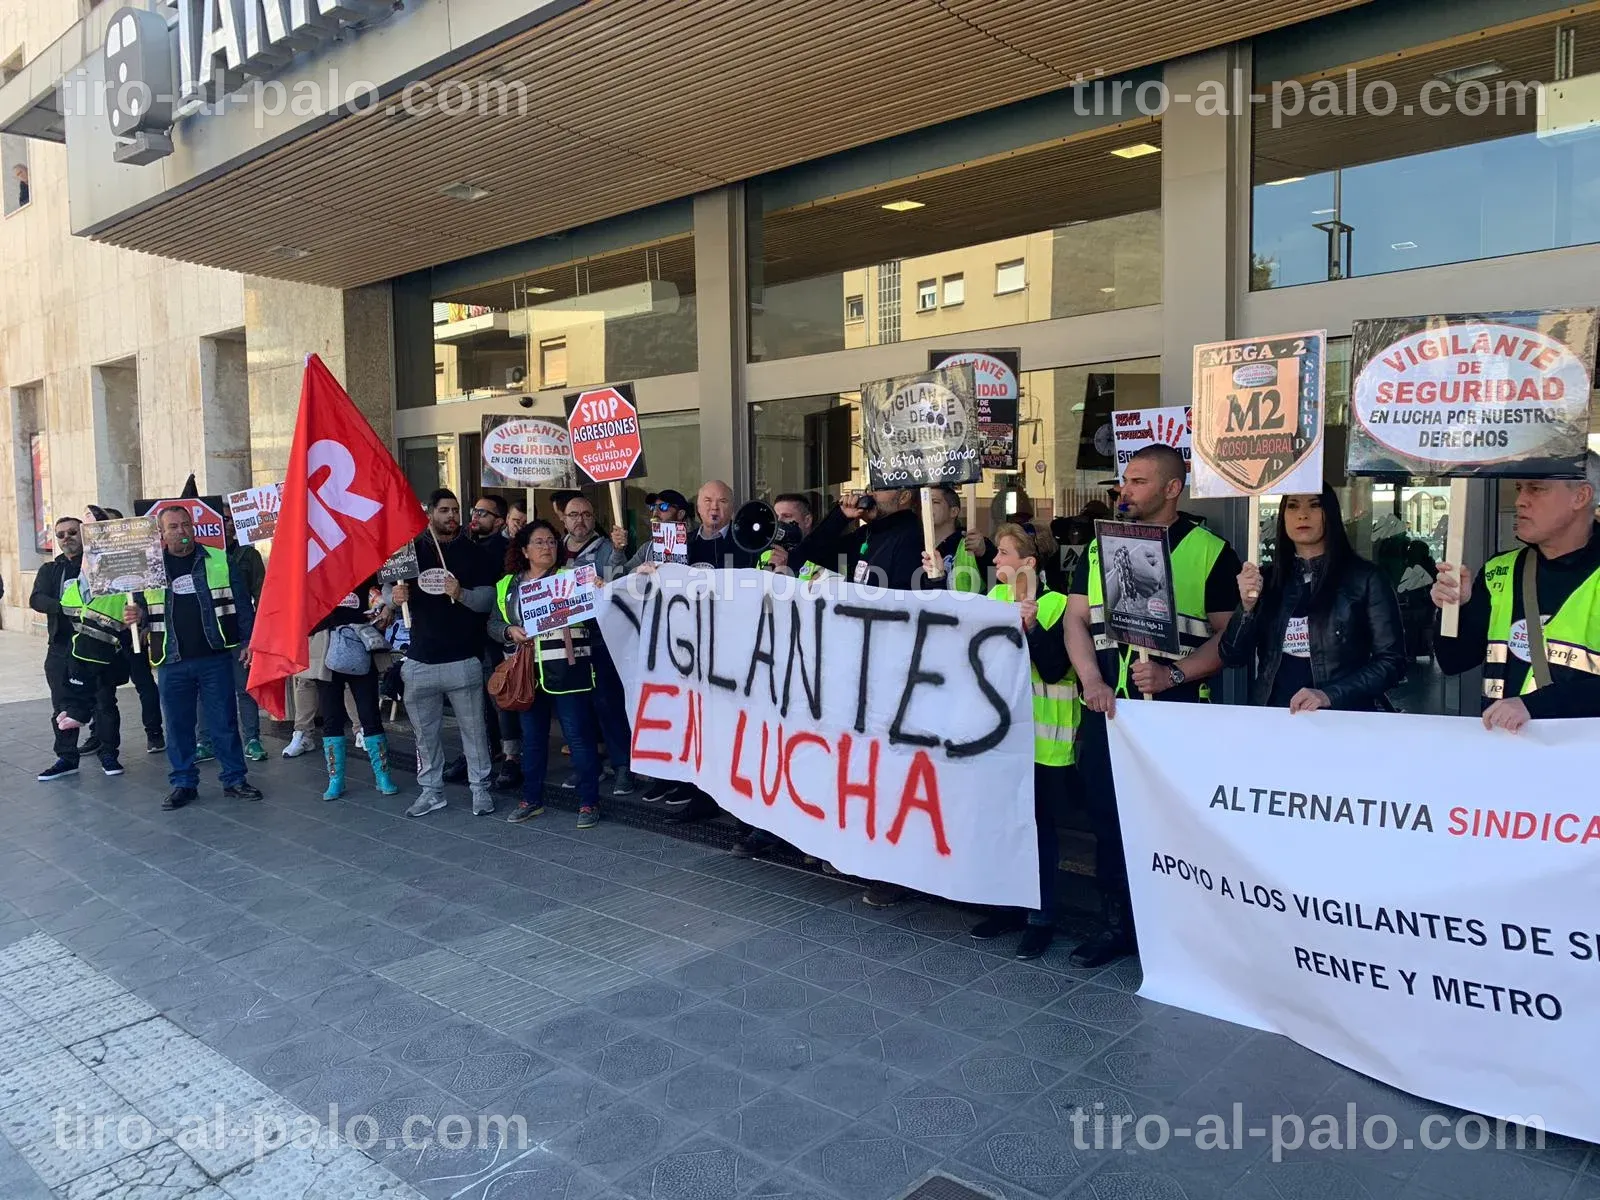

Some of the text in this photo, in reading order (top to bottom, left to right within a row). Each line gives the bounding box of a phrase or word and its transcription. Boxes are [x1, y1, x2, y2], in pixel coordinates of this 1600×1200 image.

[1209, 344, 1275, 366] MEGA
[1382, 333, 1561, 373] VIGILANTE
[1457, 361, 1482, 375] DE
[1375, 376, 1565, 404] SEGURIDAD
[580, 396, 619, 423] STOP
[1225, 389, 1285, 433] M2
[1369, 407, 1567, 425] EN LUCHA POR NUESTROS
[495, 423, 568, 442] VIGILANTE
[573, 417, 636, 443] AGRESIONES
[1418, 430, 1509, 448] DERECHOS
[493, 443, 571, 456] SEGURIDAD
[596, 440, 615, 450] A LA
[1215, 437, 1294, 457] ACOSO LABORAL
[501, 457, 523, 465] LUCHA
[524, 457, 537, 465] POR
[539, 457, 568, 466] NUESTRO
[582, 448, 633, 464] SEGURIDAD
[869, 455, 887, 470] Nos
[926, 445, 976, 464] matando
[513, 467, 551, 475] DERECHOS
[590, 460, 629, 474] PRIVADA
[882, 469, 908, 485] poco
[913, 469, 922, 479] a
[611, 581, 1024, 758] VIGILANTES
[631, 682, 952, 856] EN LUCHA
[1208, 784, 1434, 833] ALTERNATIVA
[1151, 851, 1214, 892] APOYO
[1220, 876, 1235, 899] A
[1239, 880, 1287, 912] LOS
[1293, 893, 1488, 947] VIGILANTES
[1500, 922, 1555, 956] DE
[1293, 946, 1564, 1022] RENFE Y METRO
